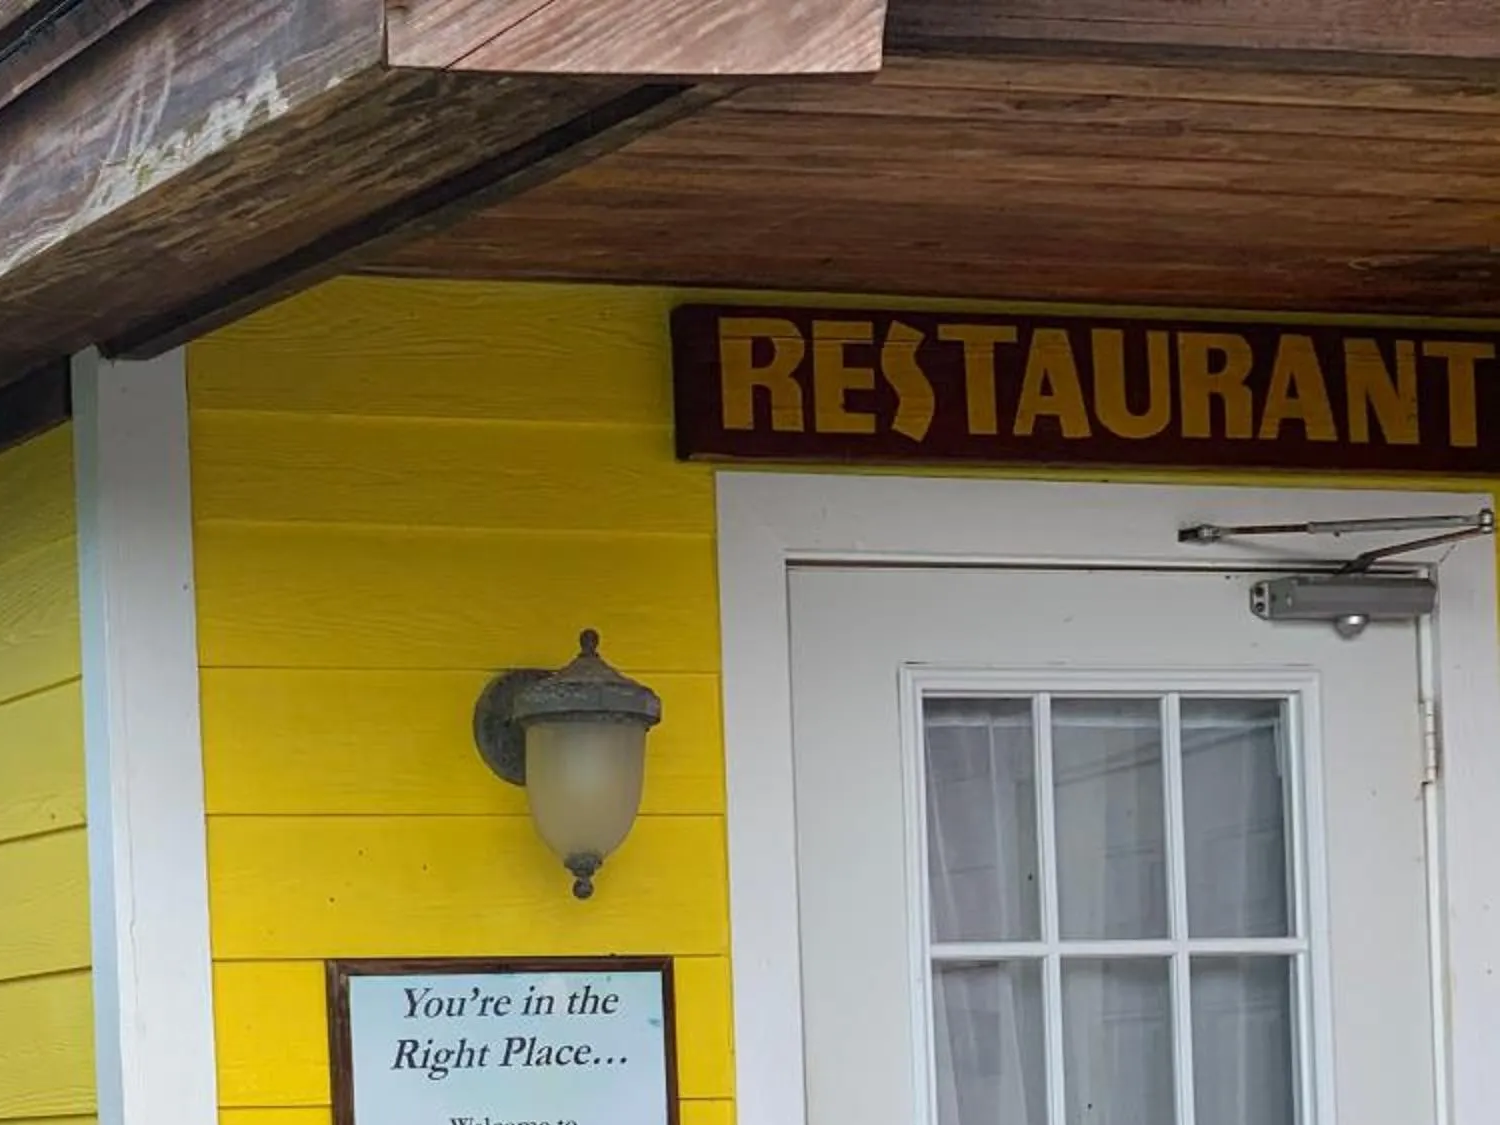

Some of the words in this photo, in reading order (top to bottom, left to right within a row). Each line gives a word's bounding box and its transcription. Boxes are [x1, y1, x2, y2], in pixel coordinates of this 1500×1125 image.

[717, 315, 1496, 448] RESTAURANT
[522, 985, 554, 1016] in
[567, 984, 620, 1016] the
[390, 1038, 491, 1081] Right
[499, 1036, 628, 1068] Place...
